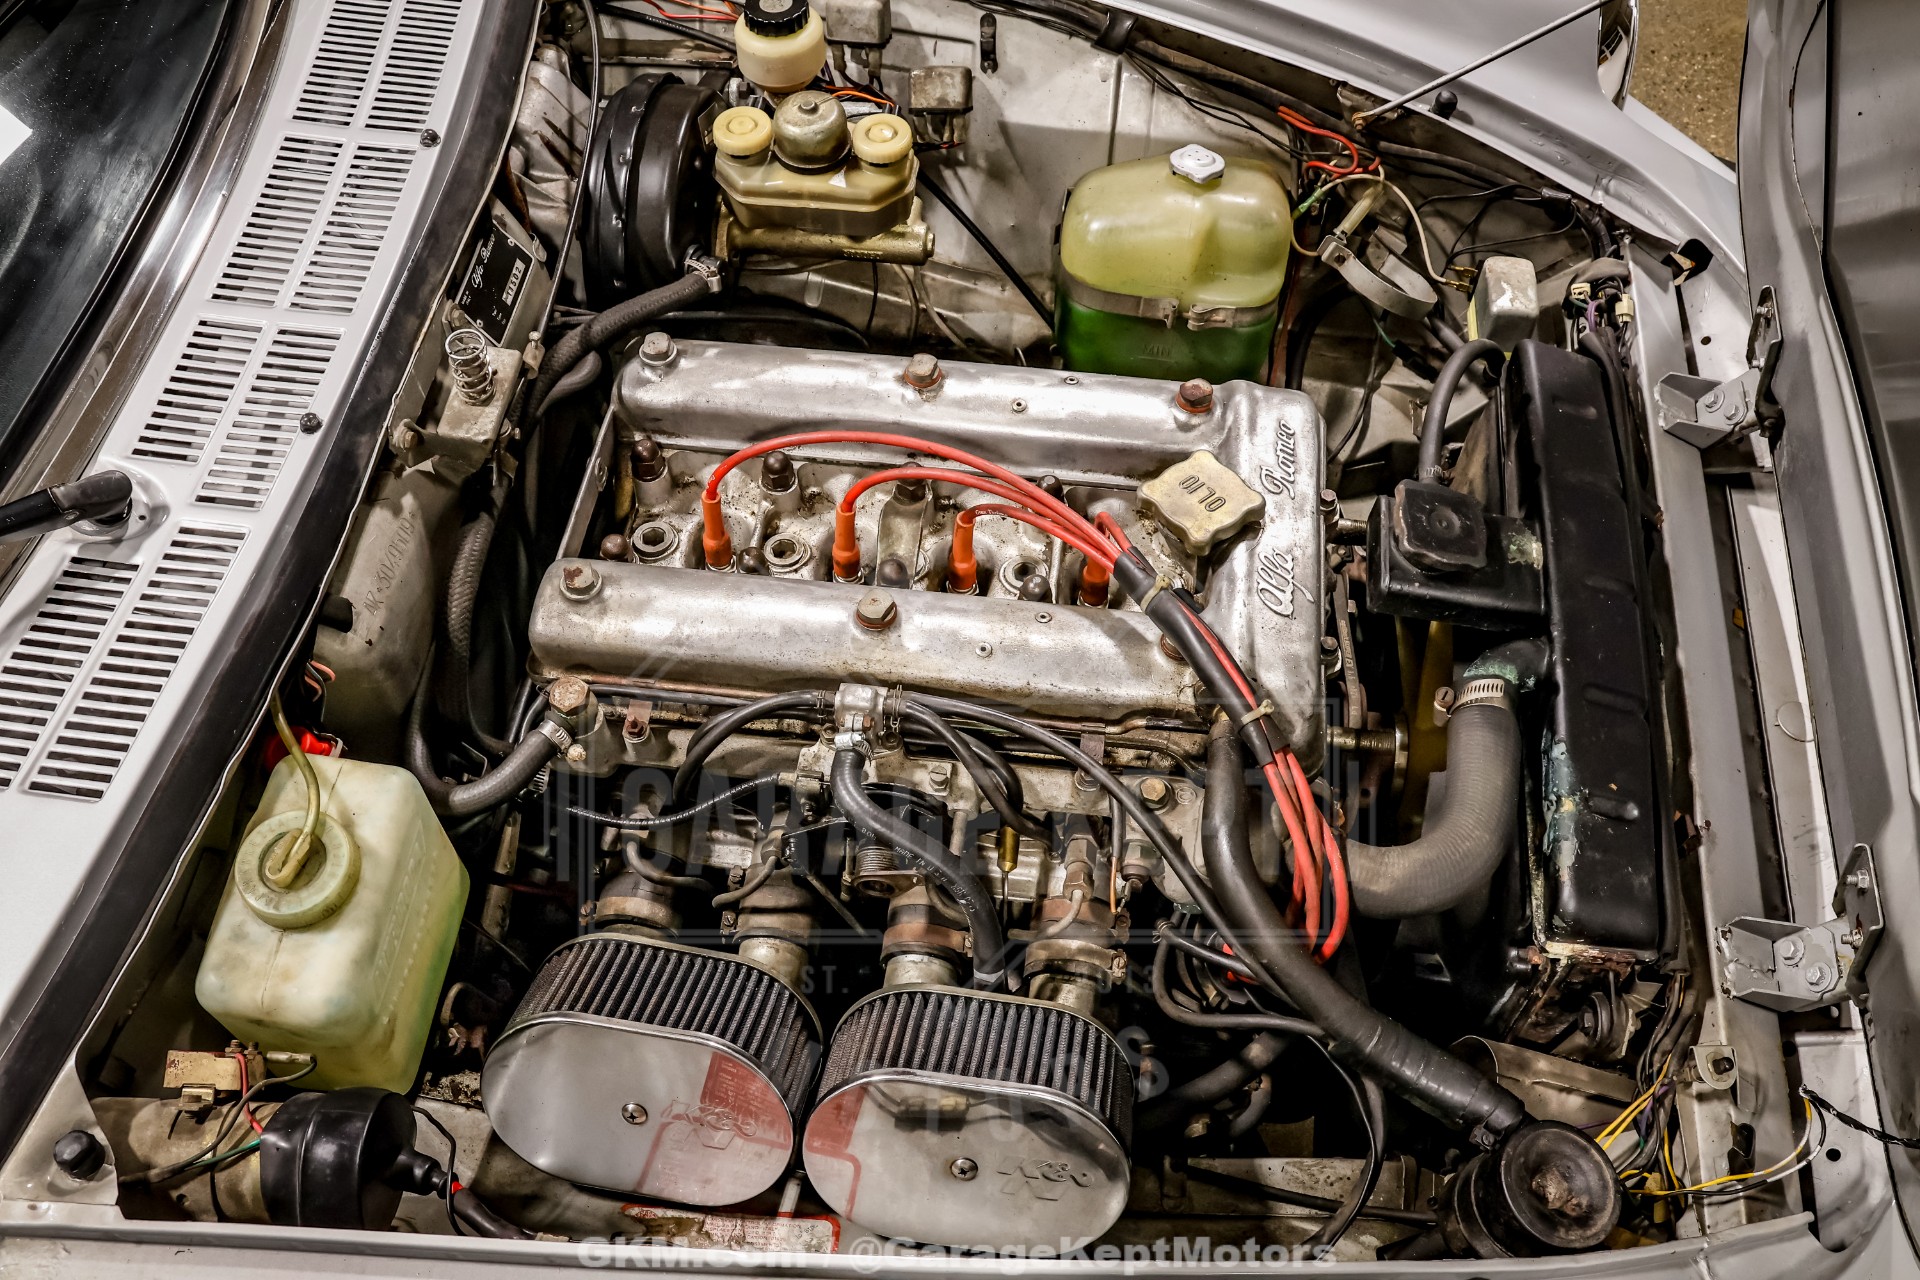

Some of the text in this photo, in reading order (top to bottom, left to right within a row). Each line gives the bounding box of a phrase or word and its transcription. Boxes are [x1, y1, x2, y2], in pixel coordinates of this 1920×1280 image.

[471, 264, 484, 289] Alfa
[1178, 474, 1227, 513] OLIO
[1256, 419, 1315, 620] Alfa Romeo
